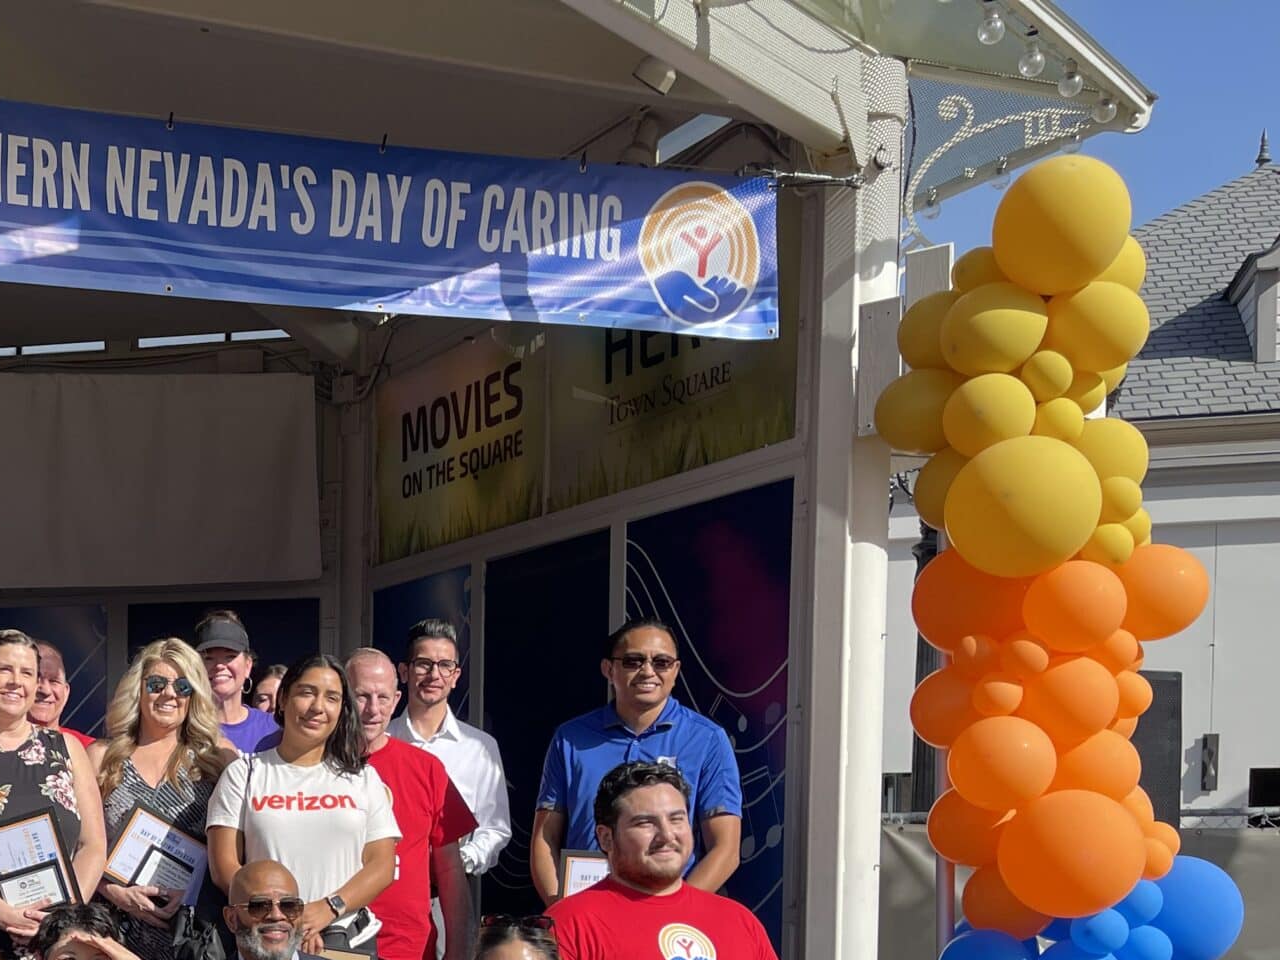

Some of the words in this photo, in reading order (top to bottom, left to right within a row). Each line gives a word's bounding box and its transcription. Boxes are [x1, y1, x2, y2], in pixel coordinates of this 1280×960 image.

[106, 142, 317, 235] NEVADA'S
[329, 169, 412, 244] DAY
[421, 178, 472, 249] OF
[478, 184, 622, 263] CARING
[401, 361, 523, 463] MOVIES
[402, 470, 422, 499] ON
[426, 457, 455, 490] THE
[459, 430, 523, 481] SQUARE
[252, 791, 357, 812] verizon
